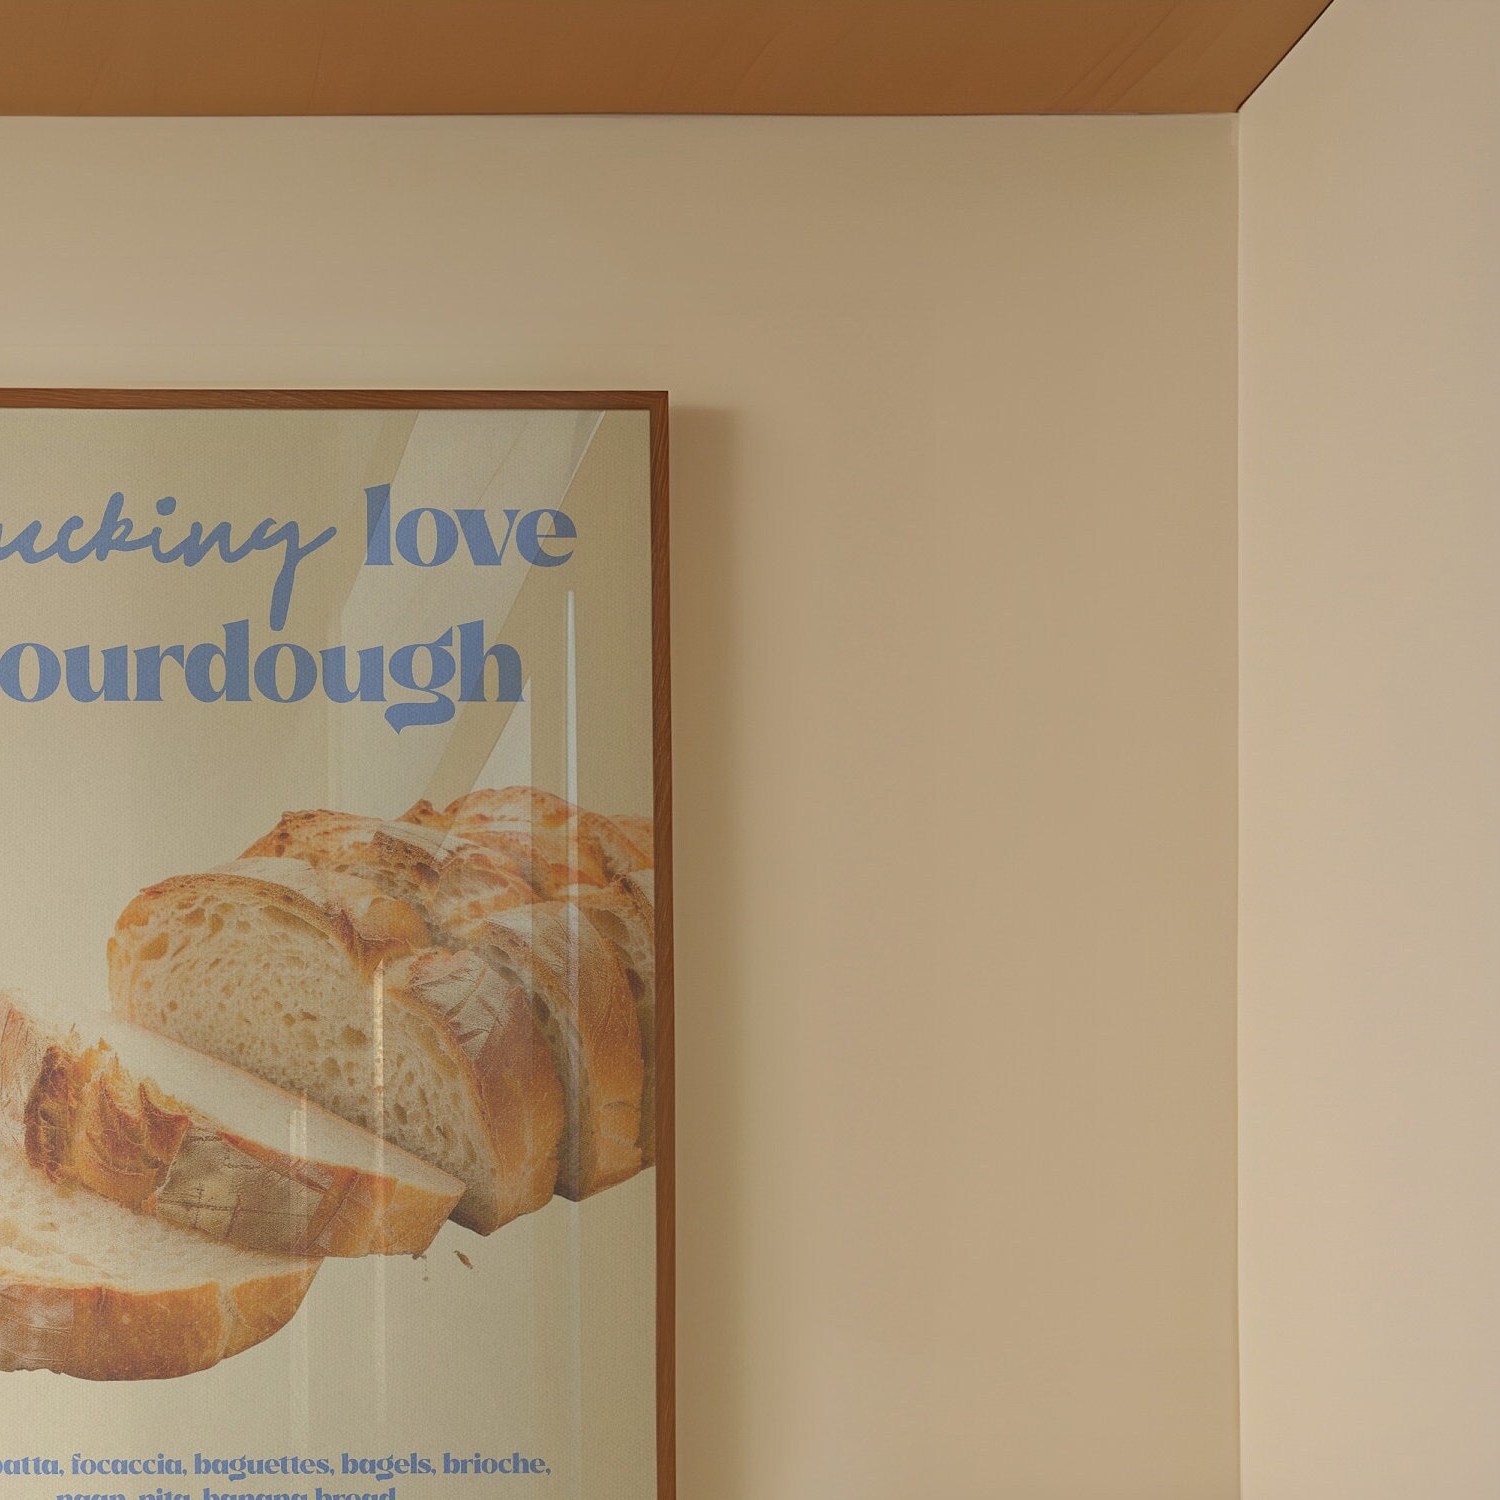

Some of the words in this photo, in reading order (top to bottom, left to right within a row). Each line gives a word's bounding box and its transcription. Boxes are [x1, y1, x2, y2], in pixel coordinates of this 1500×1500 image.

[363, 484, 576, 568] love
[71, 1452, 188, 1477] focaccia,
[194, 1452, 335, 1482] baguettes,
[341, 1452, 437, 1482] bagels,
[443, 1452, 552, 1476] brioche,
